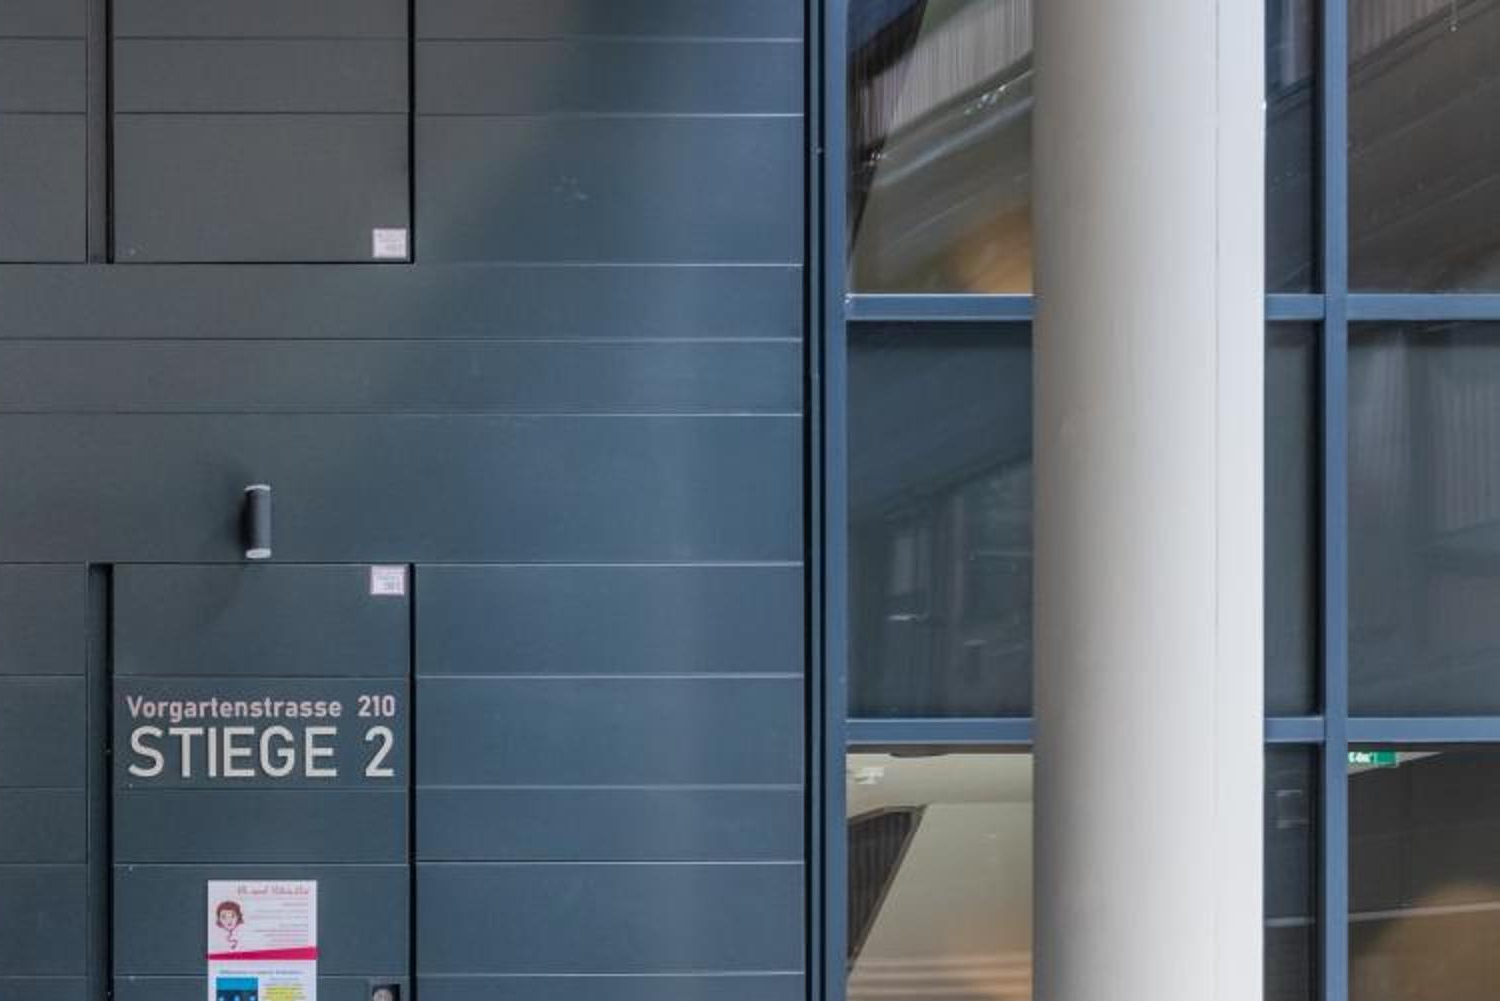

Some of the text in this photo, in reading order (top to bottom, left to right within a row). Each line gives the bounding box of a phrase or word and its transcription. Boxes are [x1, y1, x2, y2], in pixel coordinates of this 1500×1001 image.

[127, 695, 396, 723] Vorgartenstrasse 210
[128, 726, 394, 778] STIEGE 2
